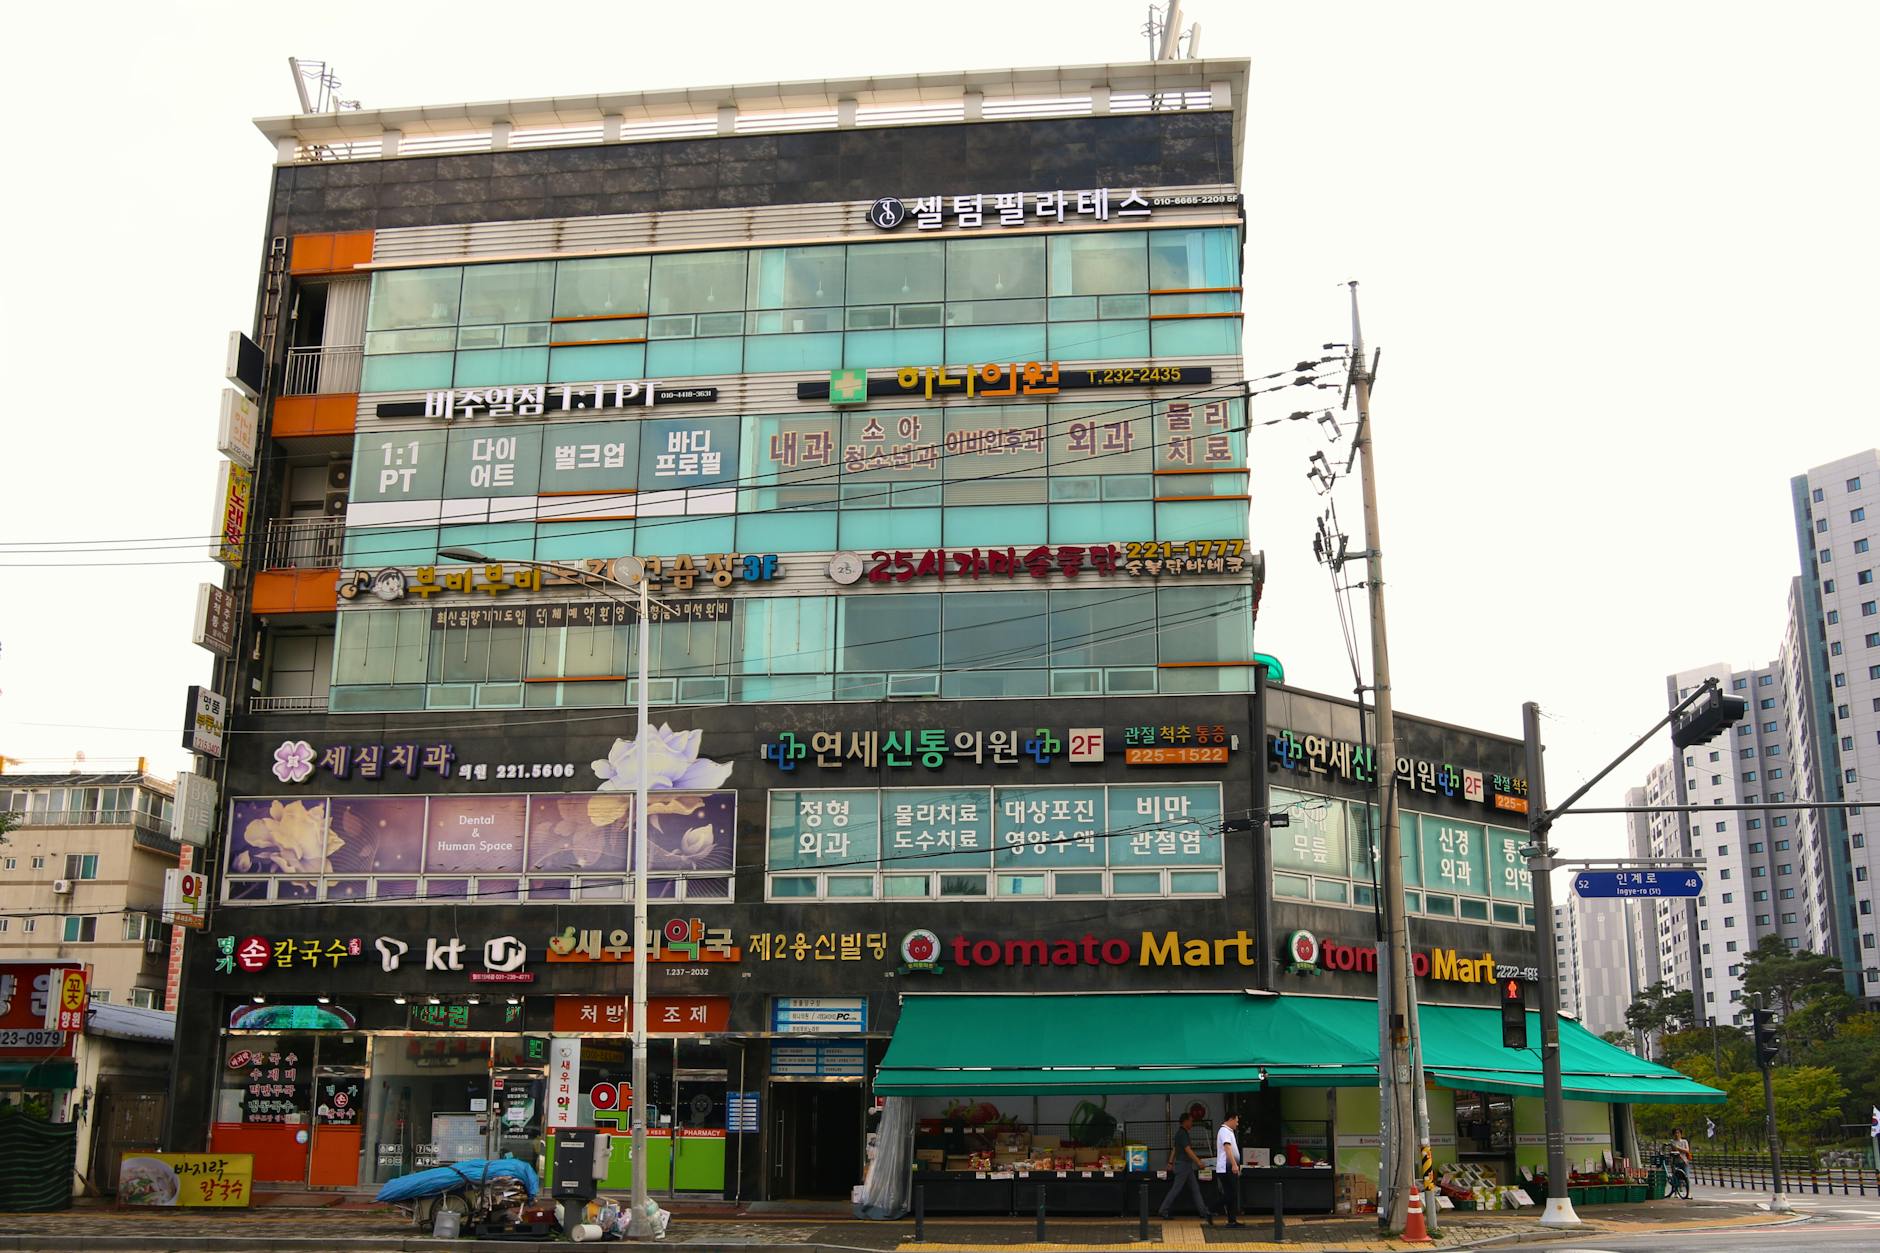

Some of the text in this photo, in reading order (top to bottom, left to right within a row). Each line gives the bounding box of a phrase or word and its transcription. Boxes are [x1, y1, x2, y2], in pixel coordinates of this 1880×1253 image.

[911, 187, 1151, 231] 셀텀필라테스
[1153, 196, 1225, 206] 010-6665-2209
[896, 361, 1060, 400] 하나의원
[1087, 367, 1181, 385] T.232-2435
[424, 382, 662, 420] 비주얼짐 1:1 PT
[1166, 400, 1230, 431] 물리
[667, 430, 711, 453] 바디
[861, 416, 921, 442] 소아
[945, 427, 1045, 456] 이비인후과
[1068, 420, 1135, 456] 외과
[381, 441, 420, 467] 1:1
[471, 437, 516, 462] 다이
[554, 443, 626, 470] 벌크업
[770, 429, 835, 468] 내과
[843, 443, 939, 474] 청소년과
[1168, 433, 1233, 465] 치료
[470, 463, 515, 489] 어트
[654, 452, 722, 477] 프로필
[379, 469, 417, 493] PT
[226, 485, 244, 546] 노래방
[1125, 539, 1245, 560] 221-1777
[408, 565, 541, 597] 부비부비
[742, 554, 778, 582] 3F
[203, 695, 220, 715] 명품
[196, 713, 223, 738] 부동산
[1124, 725, 1226, 745] 관절 척추 통증
[319, 743, 575, 780] 세실치과 의원 221.5606
[810, 728, 1102, 769] 연세신통의원 2F
[1131, 748, 1224, 763] 225-1522
[1304, 734, 1483, 796] 연세신의원 2F
[190, 780, 210, 804] BK
[1492, 773, 1511, 793] 관절
[188, 804, 209, 827] 마트
[459, 814, 495, 826] Dental
[799, 800, 851, 826] 정형
[893, 803, 979, 825] 물리치료
[1004, 799, 1095, 825] 대상포진
[1135, 795, 1192, 824] 비만
[472, 828, 480, 838] &
[798, 832, 851, 858] 외과
[893, 829, 979, 852] 도수치료
[1004, 829, 1096, 855] 영양수액
[1129, 829, 1201, 856] 관절염
[1439, 827, 1469, 856] 신경
[438, 840, 513, 853] Human Space
[1293, 834, 1329, 863] 무릎
[1440, 858, 1472, 886] 외과
[1578, 872, 1697, 889] 52 인계로 48
[181, 875, 203, 915] 약
[1616, 887, 1648, 897] Ingye-ro
[215, 935, 237, 975] 명가
[425, 938, 466, 971] kt
[749, 931, 888, 962] 제2용신빌딩
[951, 930, 1255, 967] tomato Mart
[665, 968, 709, 977] T.237-2032
[1321, 938, 1497, 985] tomo Mart
[61, 1010, 82, 1029] 향원
[580, 1004, 708, 1024] 처방 조제
[0, 1031, 60, 1046] 23-0979
[556, 1059, 571, 1123] 새우리약국
[683, 1129, 721, 1138] PHARMACY
[174, 1159, 229, 1182] 바지락
[199, 1179, 243, 1202] 칼국수
